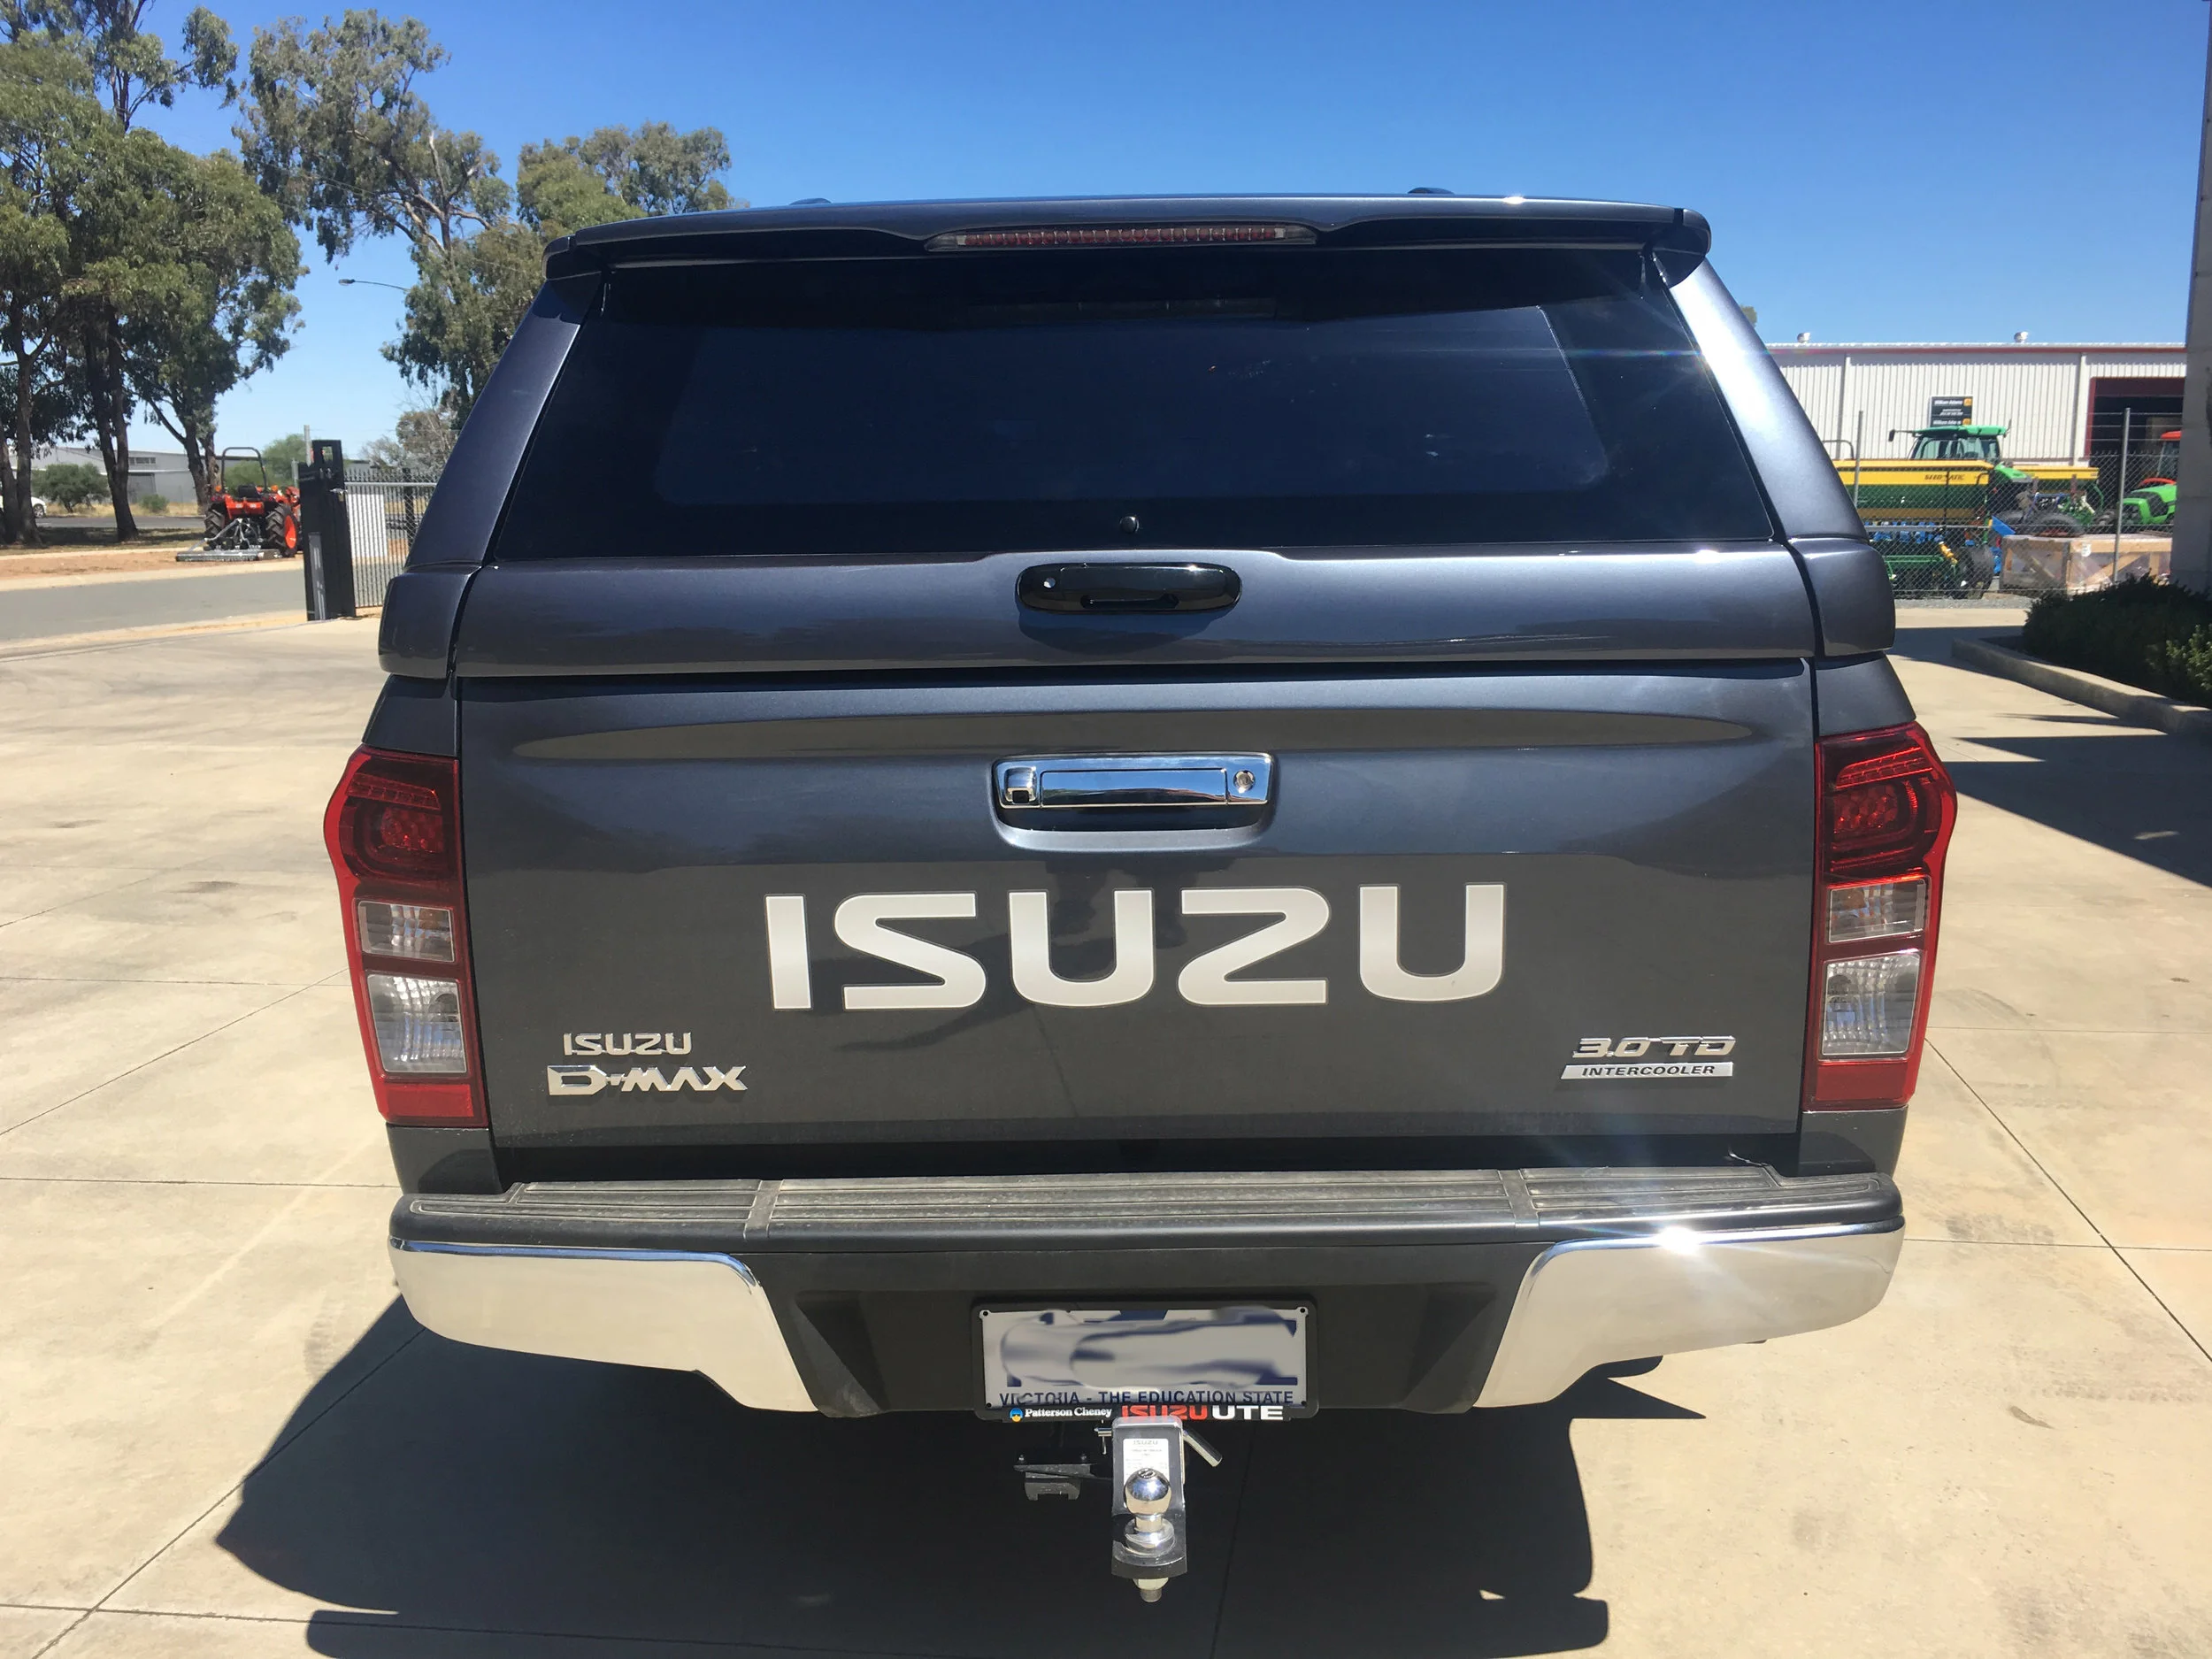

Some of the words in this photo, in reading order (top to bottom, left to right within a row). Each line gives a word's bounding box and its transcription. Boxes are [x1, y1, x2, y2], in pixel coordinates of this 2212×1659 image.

[764, 883, 1506, 1010] ISUZU
[563, 1032, 693, 1056] ISUZU
[1572, 1037, 1651, 1058] 3.0
[1659, 1035, 1737, 1056] TD
[547, 1064, 749, 1096] D-MAX
[1581, 1064, 1716, 1077] INTERCOOLER
[1098, 1391, 1132, 1404] THE
[1138, 1390, 1236, 1404] EDUCATION
[1242, 1391, 1294, 1404] STATE
[1025, 1408, 1074, 1418] Patterson
[1073, 1407, 1113, 1418] Cheney
[1121, 1404, 1209, 1421] ISUZU
[1211, 1404, 1284, 1421] UTE
